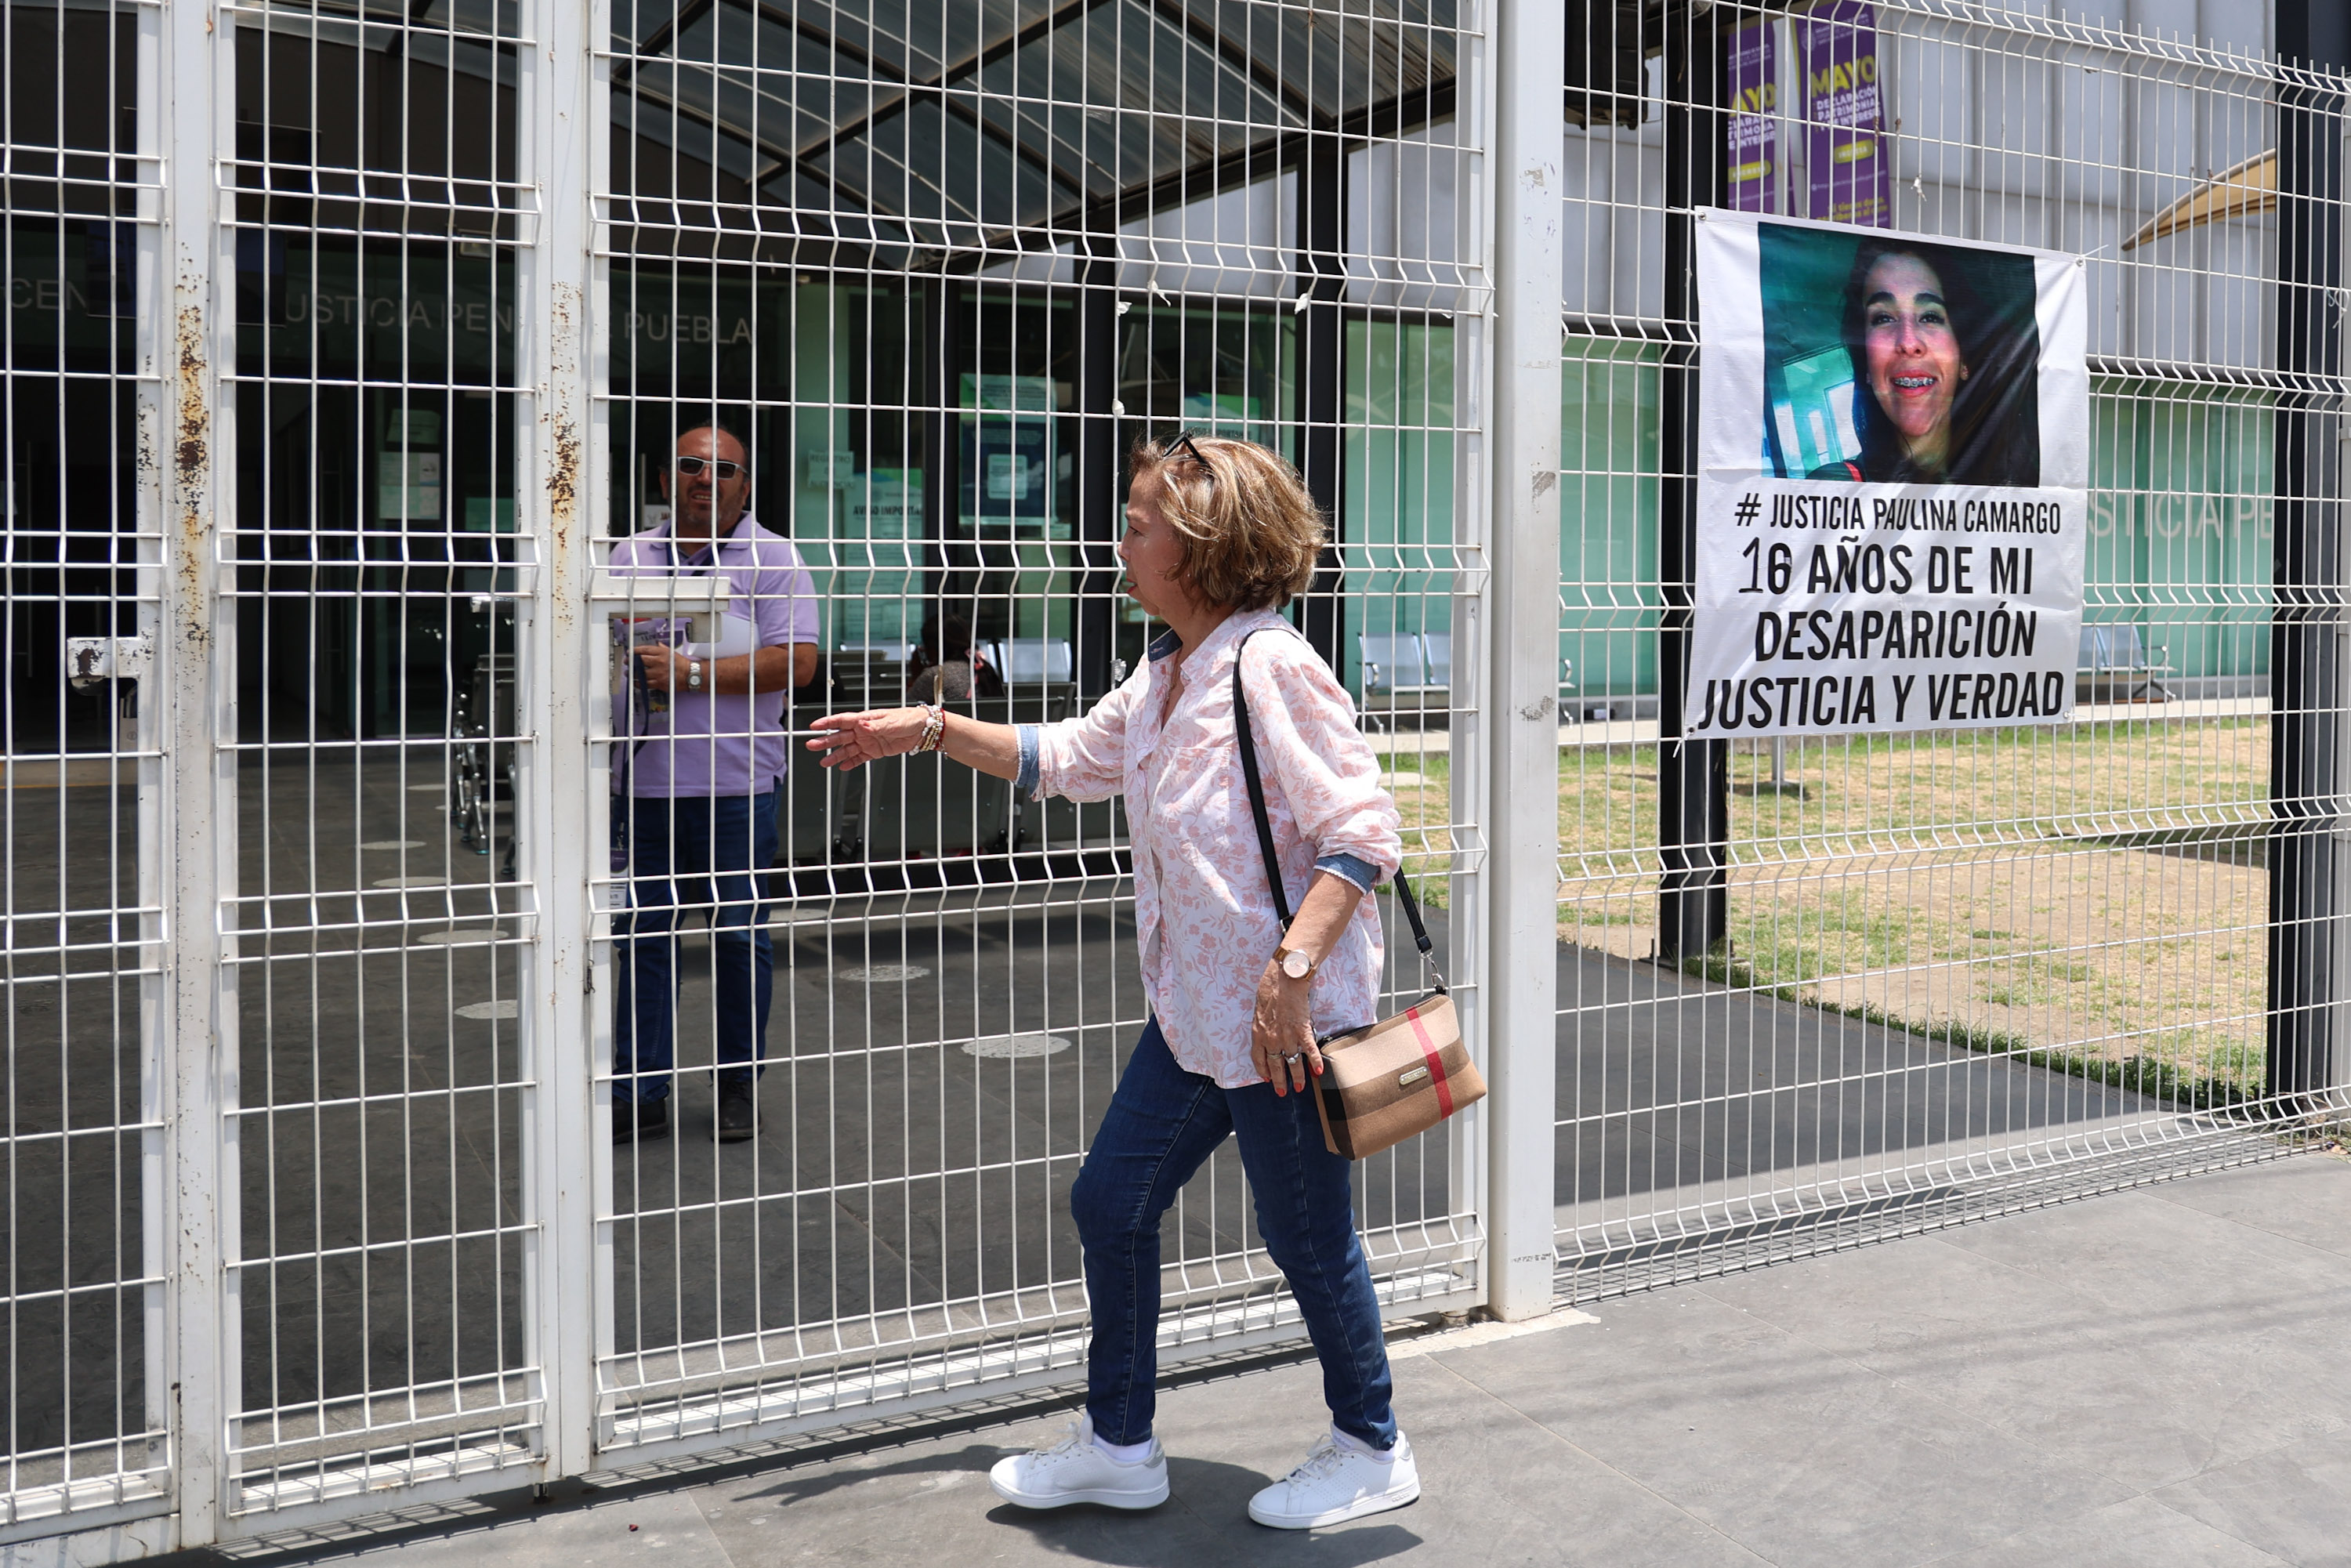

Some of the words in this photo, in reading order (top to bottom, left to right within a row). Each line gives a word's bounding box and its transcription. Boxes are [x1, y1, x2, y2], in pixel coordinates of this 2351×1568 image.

[1810, 54, 1876, 98] MAYO
[1729, 82, 1777, 117] AYO
[285, 293, 431, 328] USTICIA
[441, 302, 514, 333] PEN
[624, 313, 753, 344] PUEBLA
[1734, 492, 1762, 527] #
[1770, 494, 1865, 530] JUSTICIA
[1873, 498, 1957, 532] PAULINA
[1964, 500, 2061, 534] CAMARGO
[2088, 487, 2222, 539] STICIA
[1737, 537, 1792, 595] 16
[1806, 536, 1913, 595] AÑOS
[1927, 546, 1973, 594] DE
[1990, 547, 2033, 595] MI
[1755, 601, 2036, 661] DESAPARICIÓN
[1697, 675, 1877, 730] JUSTICIA
[1892, 675, 1916, 722] Y
[1928, 671, 2064, 721] VERDAD
